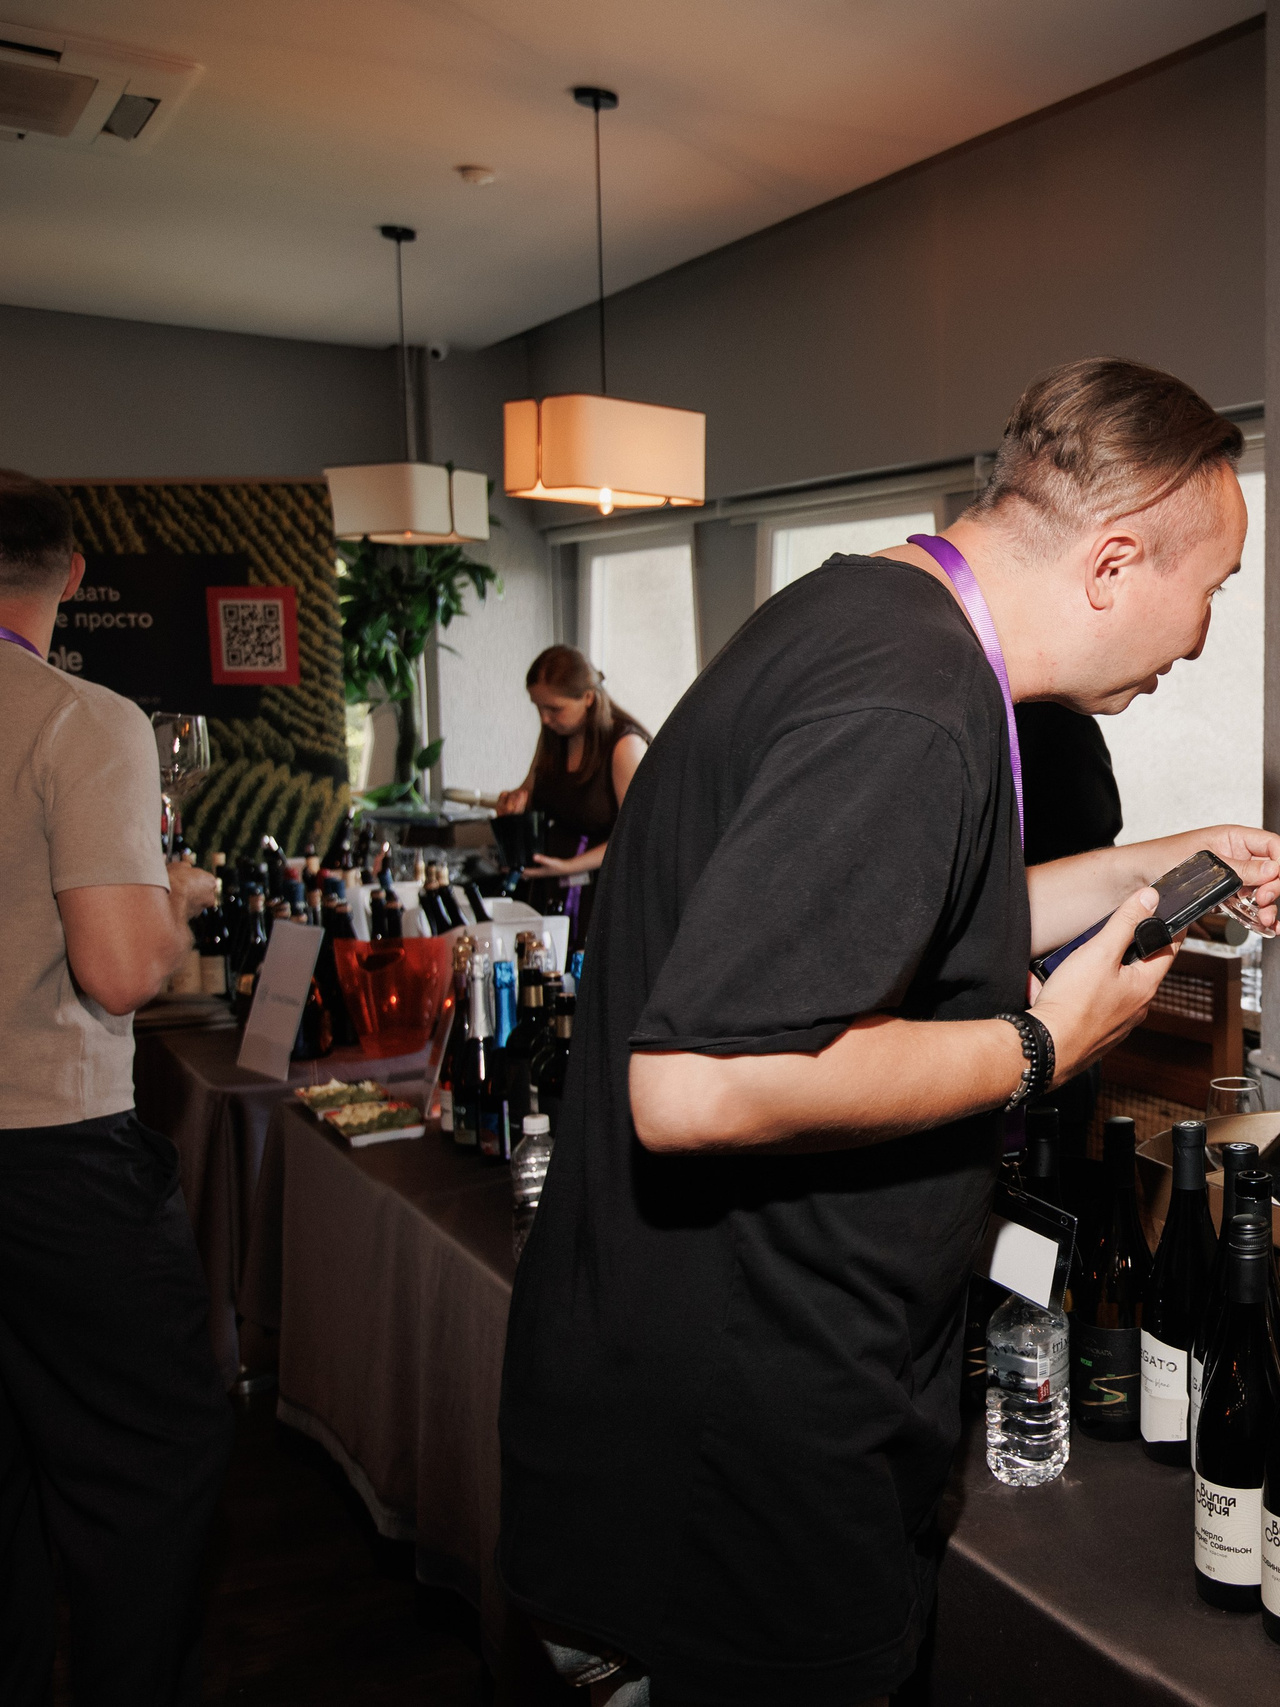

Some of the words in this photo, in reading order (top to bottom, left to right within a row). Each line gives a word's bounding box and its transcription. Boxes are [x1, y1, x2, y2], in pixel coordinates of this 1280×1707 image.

[75, 586, 120, 602] вать
[56, 612, 69, 628] е
[75, 613, 154, 633] просто
[1141, 1348, 1178, 1373] GATO
[1196, 1489, 1230, 1517] София
[1200, 1482, 1237, 1508] Вилла
[1210, 1541, 1253, 1554] совиньон
